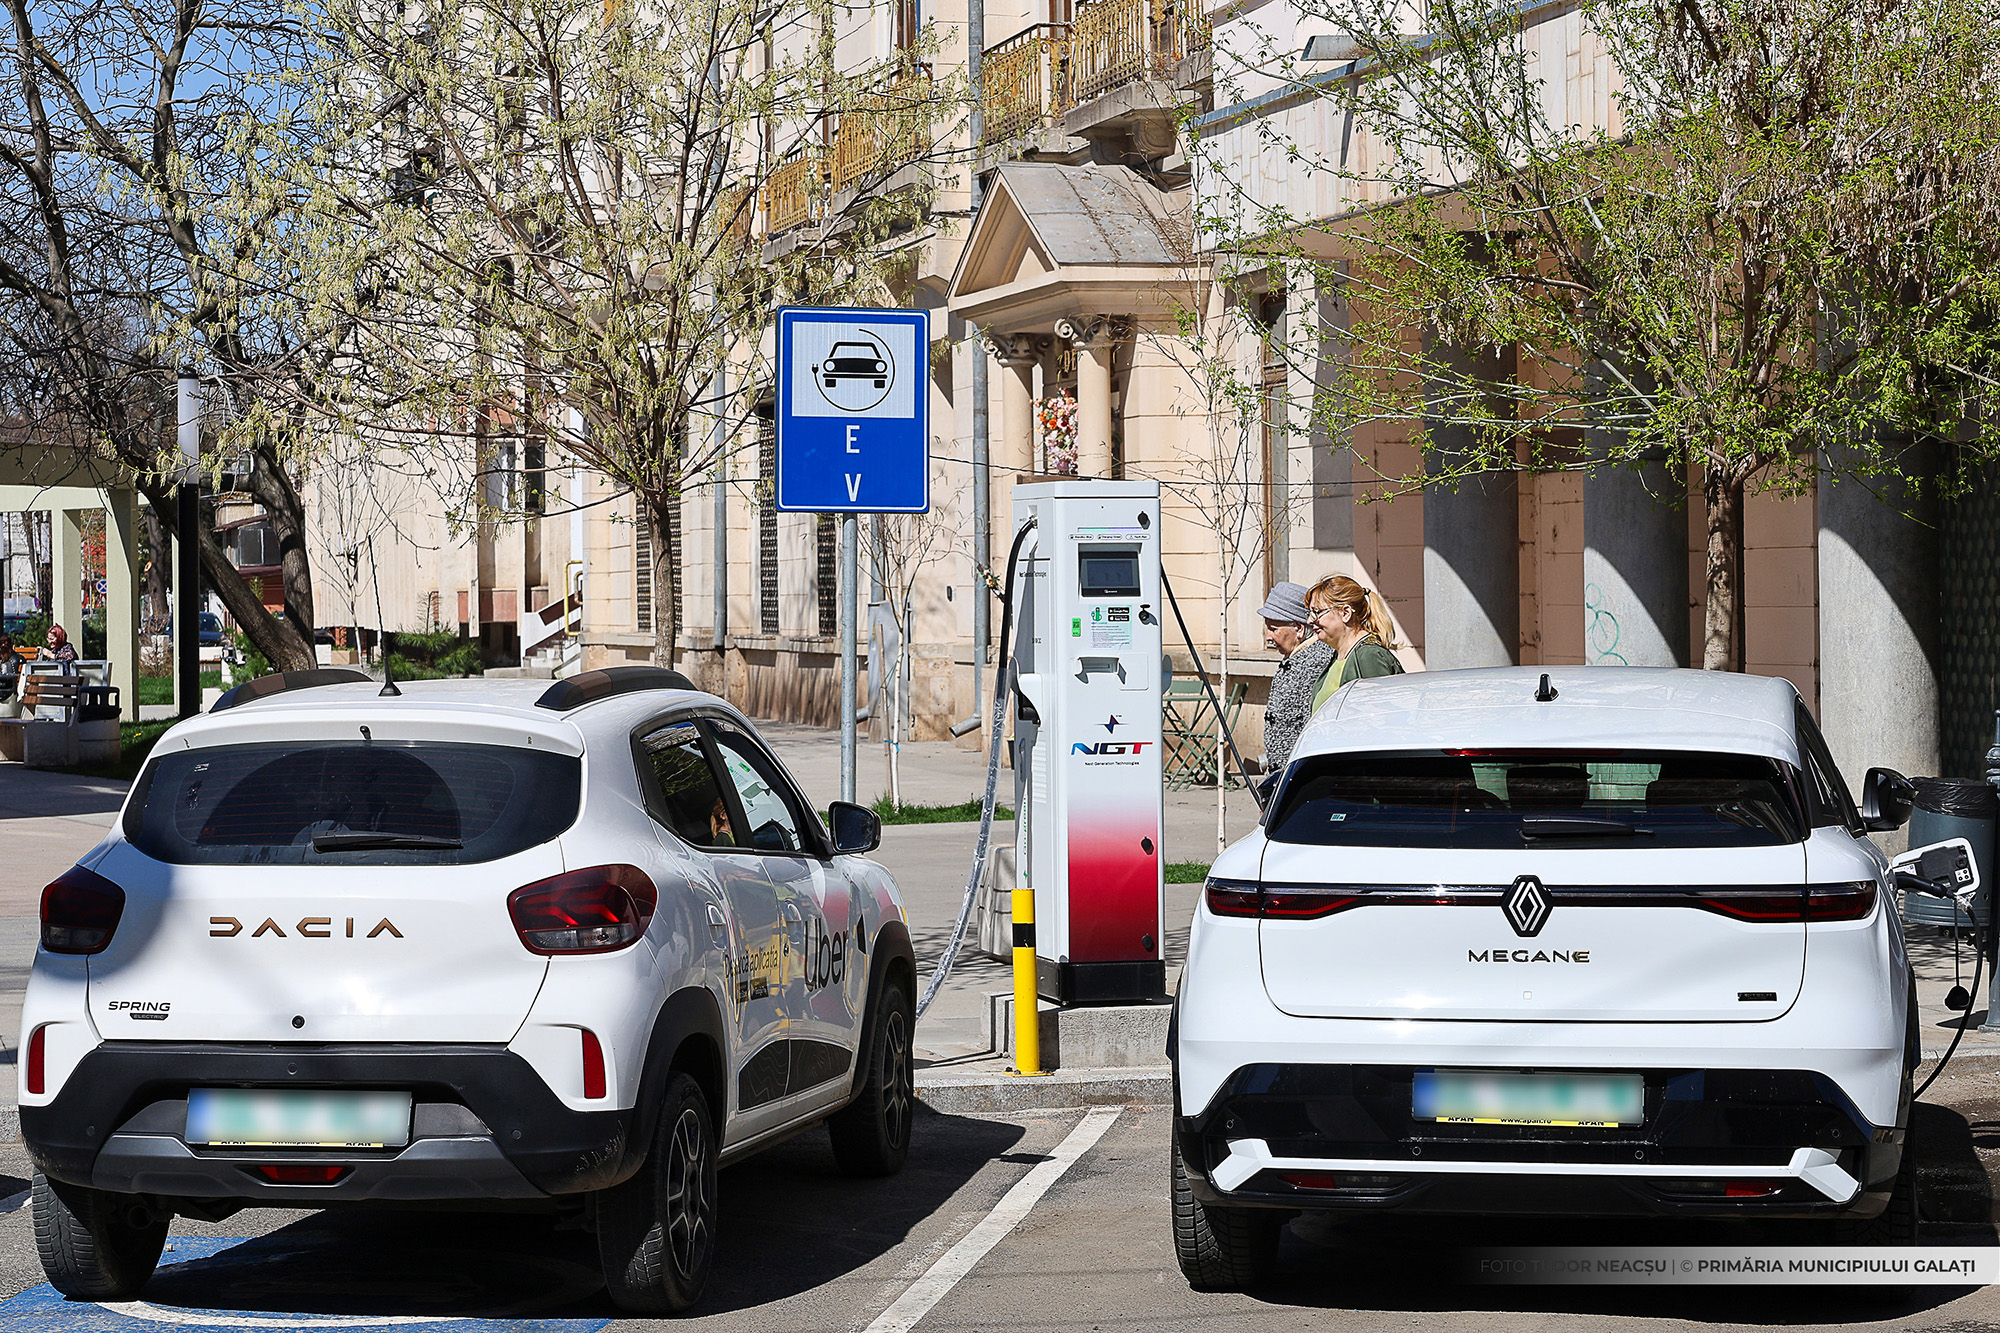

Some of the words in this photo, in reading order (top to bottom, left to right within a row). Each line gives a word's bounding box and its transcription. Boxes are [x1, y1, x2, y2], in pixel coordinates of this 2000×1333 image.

[846, 425, 860, 453] E
[845, 474, 861, 502] V
[1071, 742, 1153, 755] NGT
[209, 916, 405, 938] DACIA
[804, 917, 849, 992] Uber
[1468, 949, 1590, 963] MEGANE
[108, 1001, 171, 1012] SPRING
